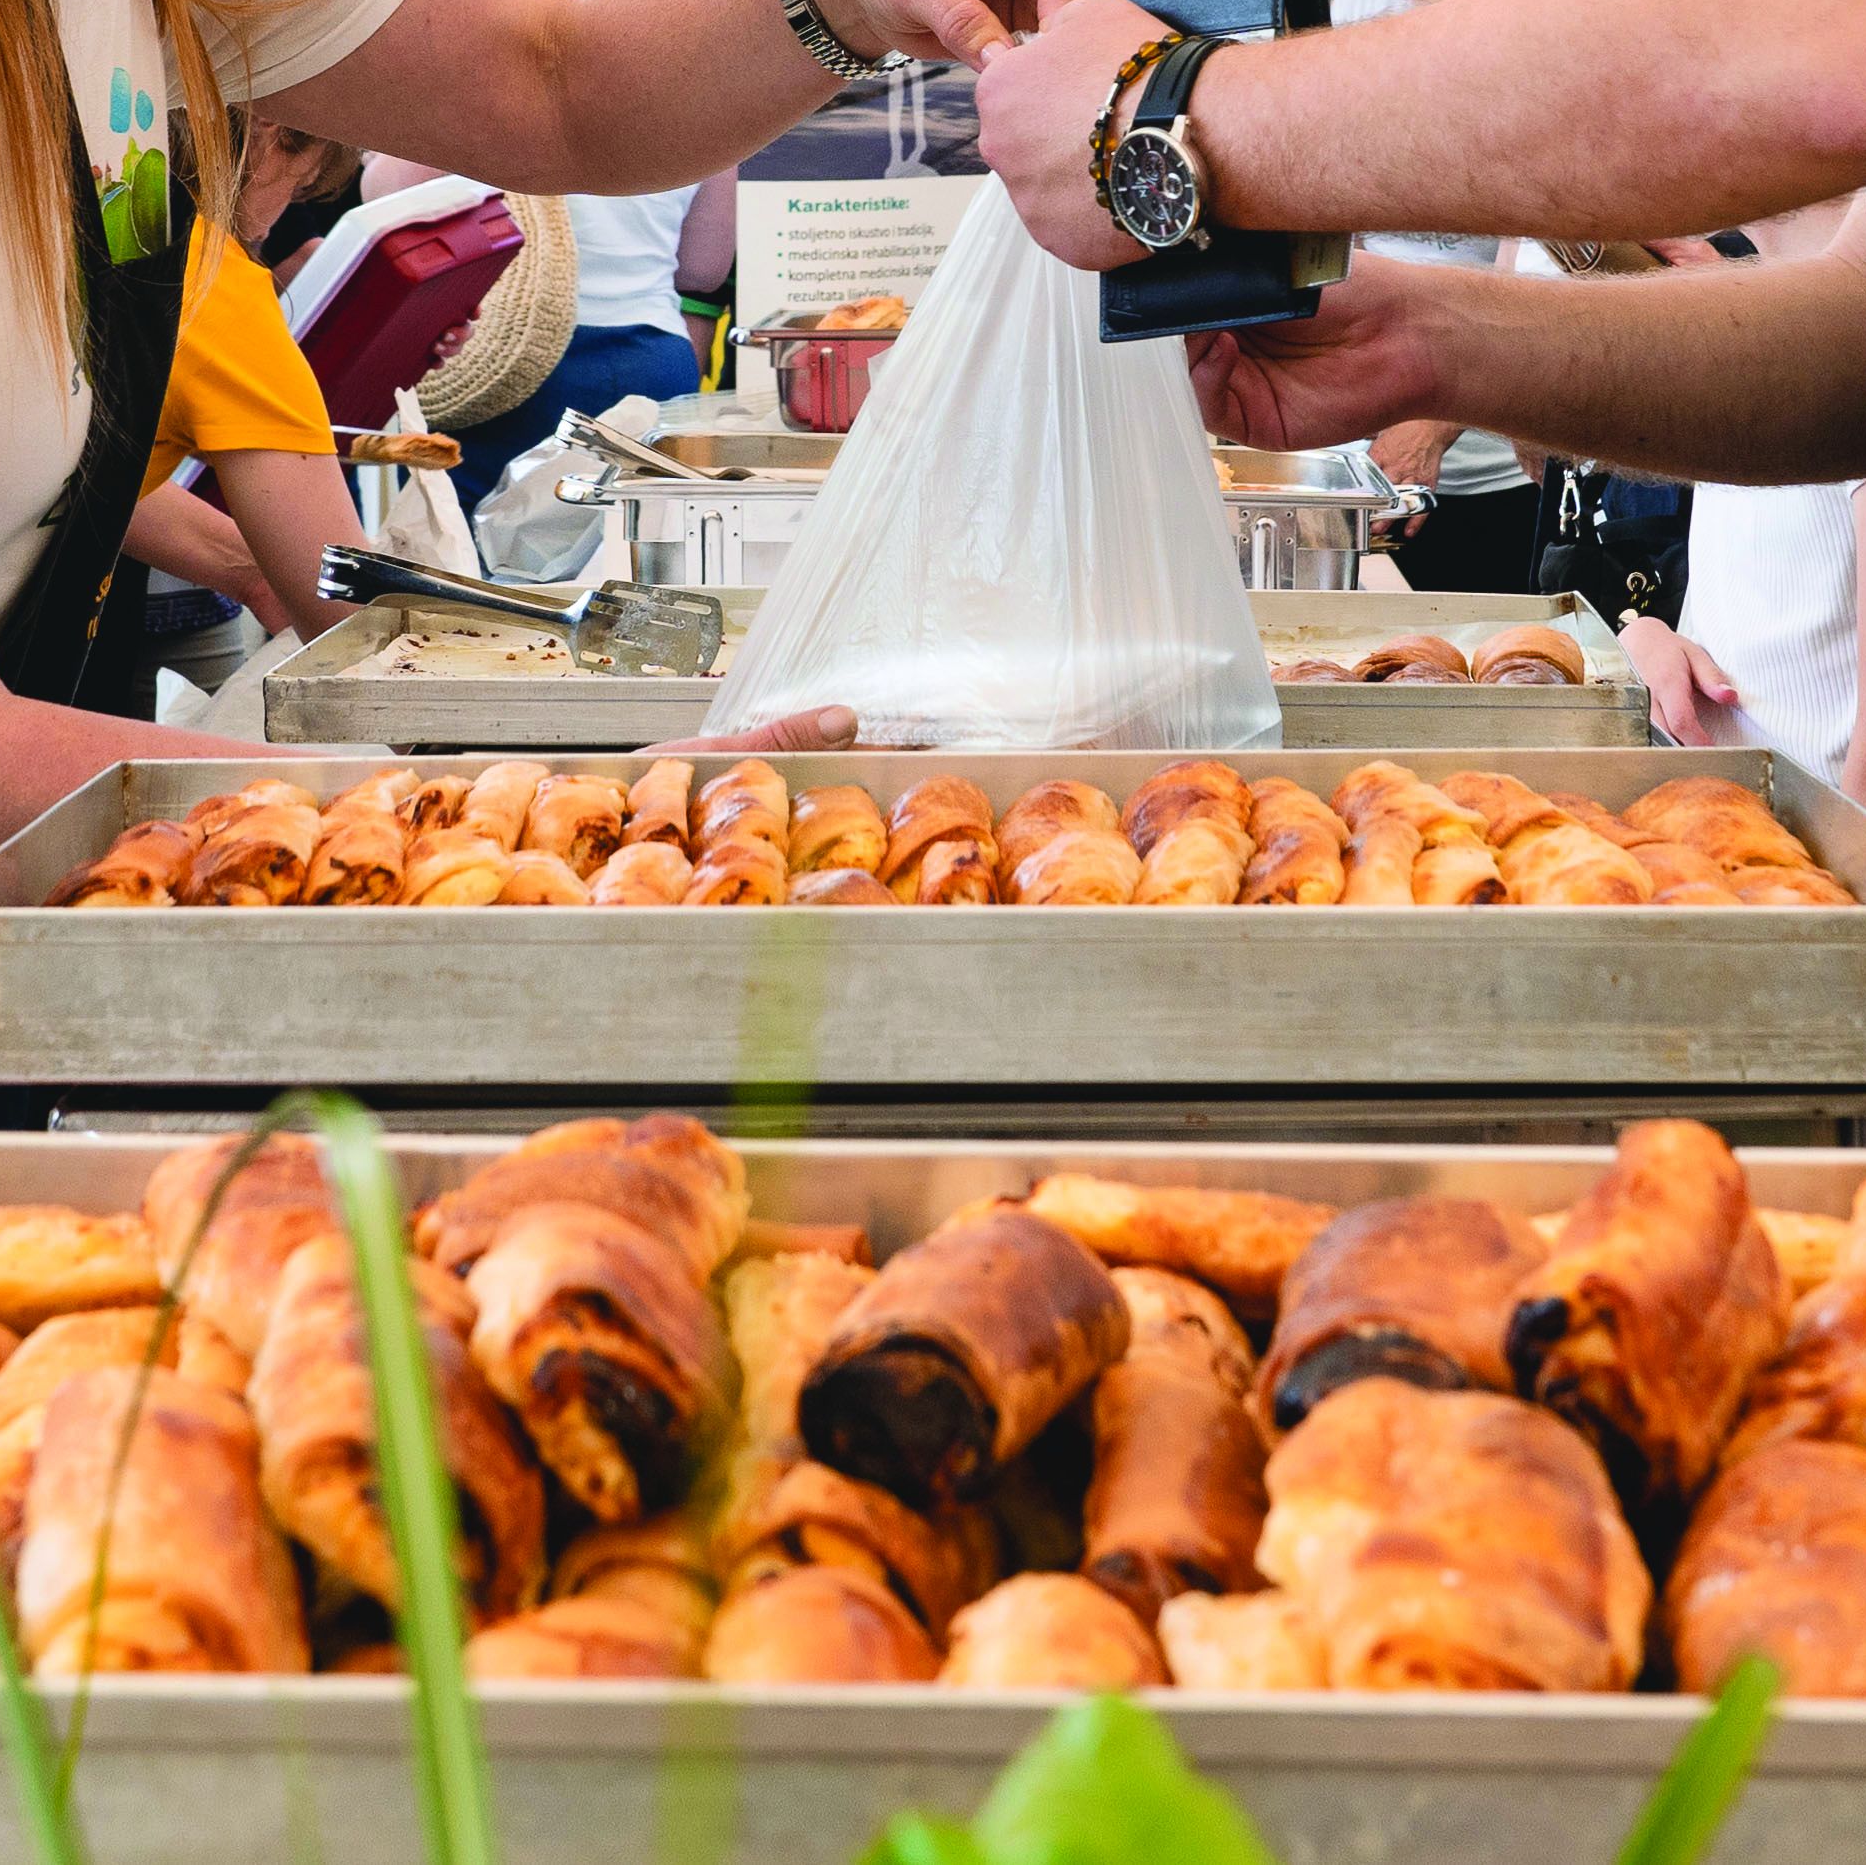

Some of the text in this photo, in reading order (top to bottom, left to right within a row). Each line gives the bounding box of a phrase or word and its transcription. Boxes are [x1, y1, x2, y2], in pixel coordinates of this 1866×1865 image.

[788, 196, 911, 213] Karakteristike:
[788, 247, 859, 261] medicinska
[788, 269, 856, 283] kompletna
